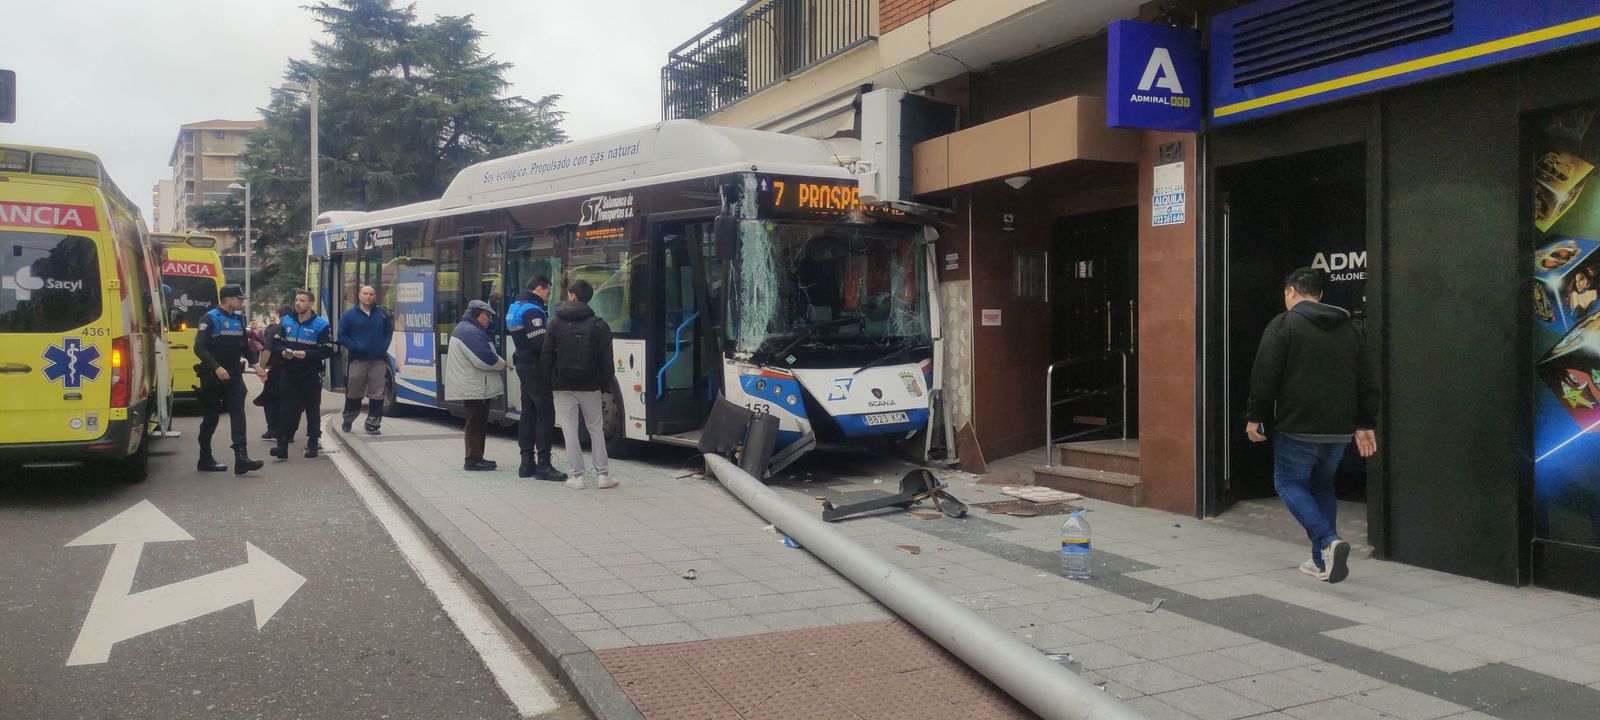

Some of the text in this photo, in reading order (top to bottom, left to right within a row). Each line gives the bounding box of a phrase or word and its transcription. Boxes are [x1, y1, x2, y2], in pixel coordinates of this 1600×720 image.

[1137, 47, 1184, 94] A
[1130, 94, 1190, 107] ADMIRAL BET
[483, 171, 494, 184] Soy
[530, 155, 571, 175] Propulsado
[573, 155, 587, 167] con
[589, 150, 605, 166] gas
[607, 139, 641, 159] natural
[773, 181, 785, 206] 7
[1154, 193, 1184, 206] ALQUILA
[46, 278, 82, 292] Sacyl
[81, 327, 111, 337] 4361
[867, 399, 896, 407] SCANIA
[867, 414, 889, 425] 8823
